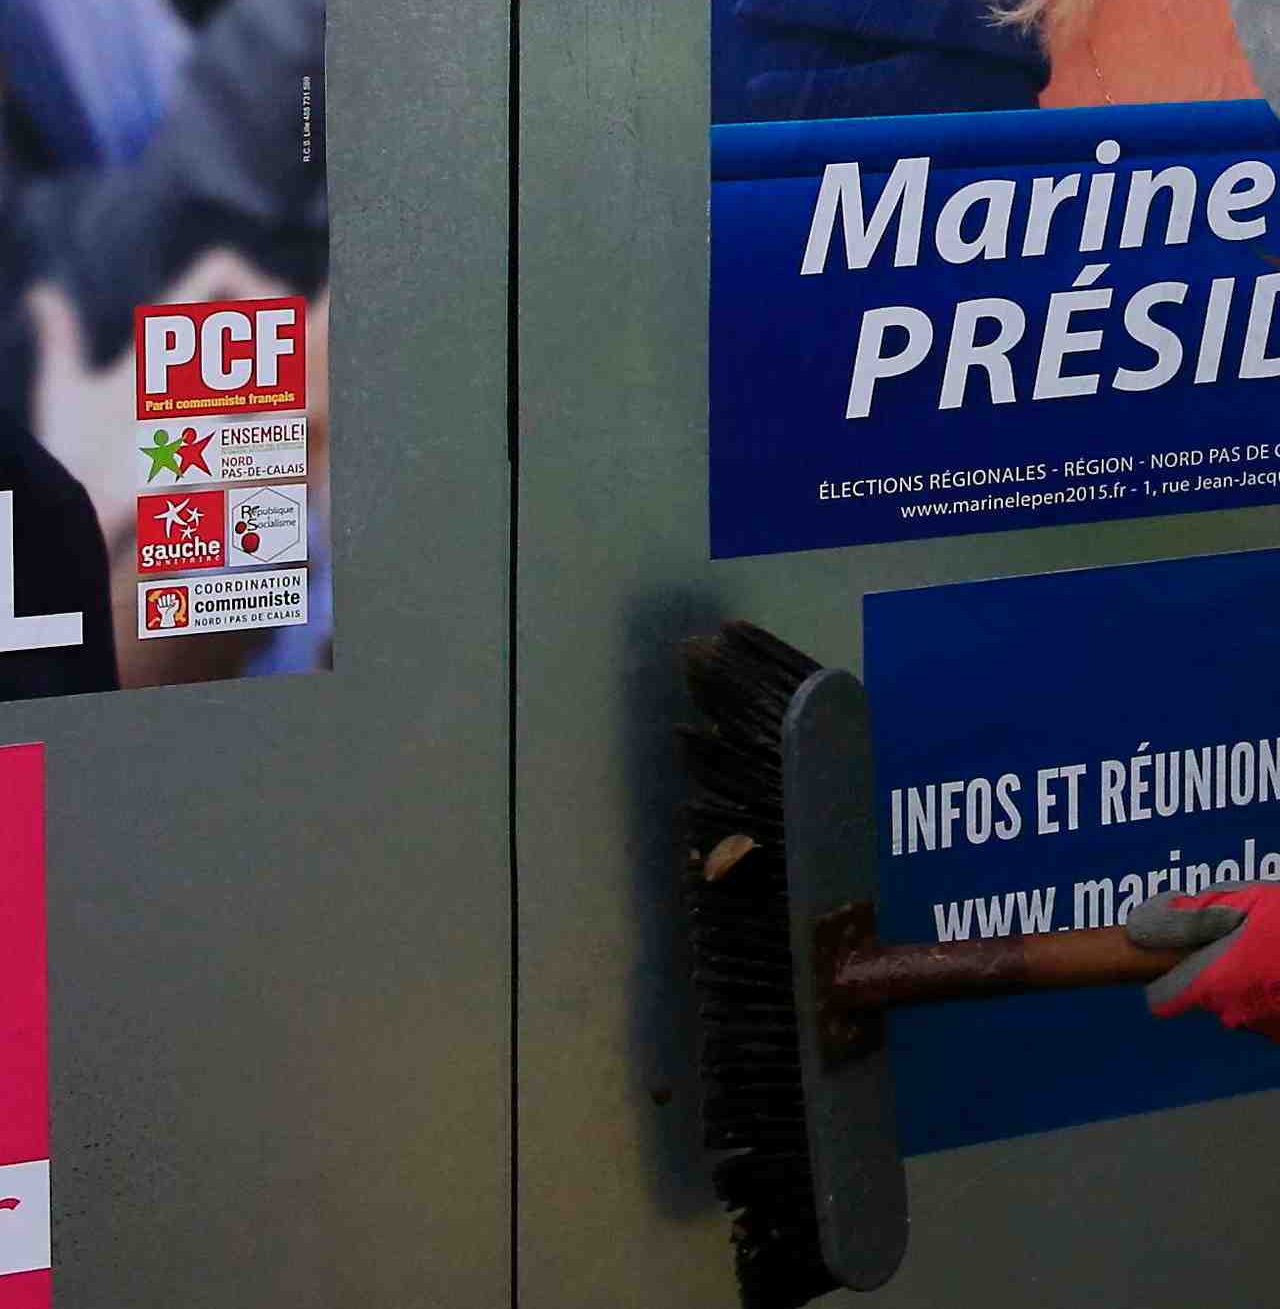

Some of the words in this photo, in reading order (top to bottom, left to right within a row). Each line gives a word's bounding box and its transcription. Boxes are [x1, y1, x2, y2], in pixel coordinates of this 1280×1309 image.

[800, 139, 1276, 275] Marine
[144, 309, 295, 395] PCF
[146, 398, 173, 412] Parti
[176, 394, 246, 410] communiste
[249, 391, 295, 406] français
[221, 424, 304, 446] ENSEMBLE!
[221, 455, 253, 467] NORD
[221, 463, 304, 478] PAS-DE-CALAIS
[818, 474, 924, 500] ÉLECTIONS
[930, 462, 1046, 490] RÉGIONALES
[1064, 454, 1133, 478] RÉGION
[1151, 450, 1202, 468] NORD
[1209, 446, 1241, 464] PAS
[1246, 443, 1270, 460] DE
[901, 483, 1126, 519] www.marinelepen2015.fr
[1143, 479, 1157, 498] 1,
[1162, 479, 1190, 494] rue
[141, 536, 220, 567] gauche
[195, 576, 301, 595] COORDINATION
[195, 591, 300, 613] communiste
[195, 617, 221, 627] NORD
[230, 615, 248, 623] PAS
[251, 613, 264, 621] DE
[267, 610, 300, 620] CALAIS
[891, 773, 1022, 856] INFOS
[1037, 764, 1087, 835] ET
